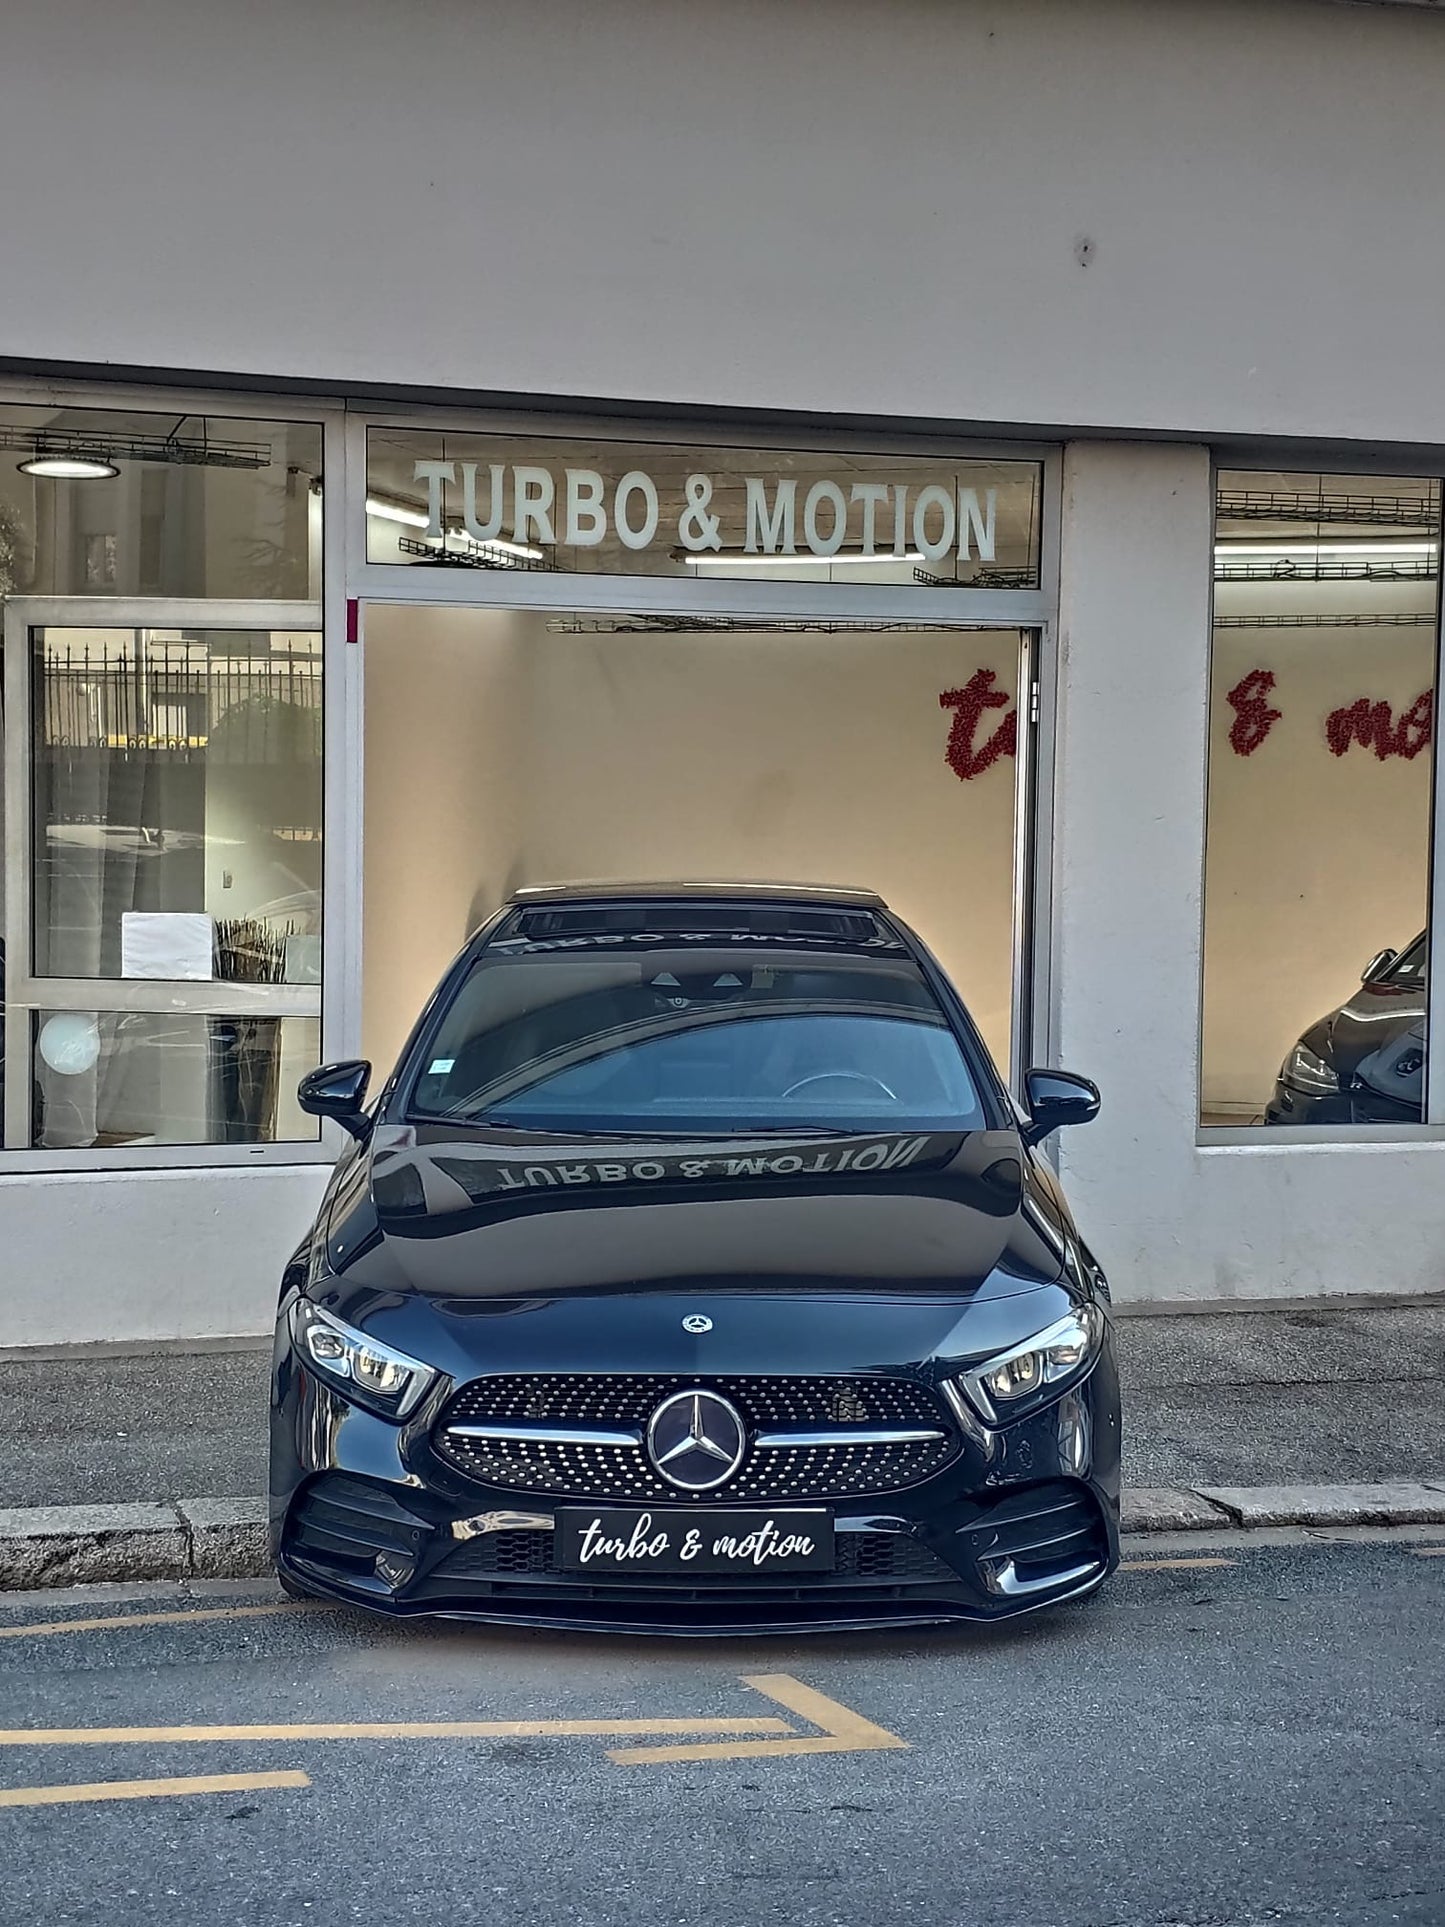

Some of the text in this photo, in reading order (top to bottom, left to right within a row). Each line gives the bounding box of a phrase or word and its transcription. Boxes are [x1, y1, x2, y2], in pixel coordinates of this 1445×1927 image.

[414, 460, 997, 563] TURBO & MOTION
[577, 1512, 815, 1566] turbo & motion
